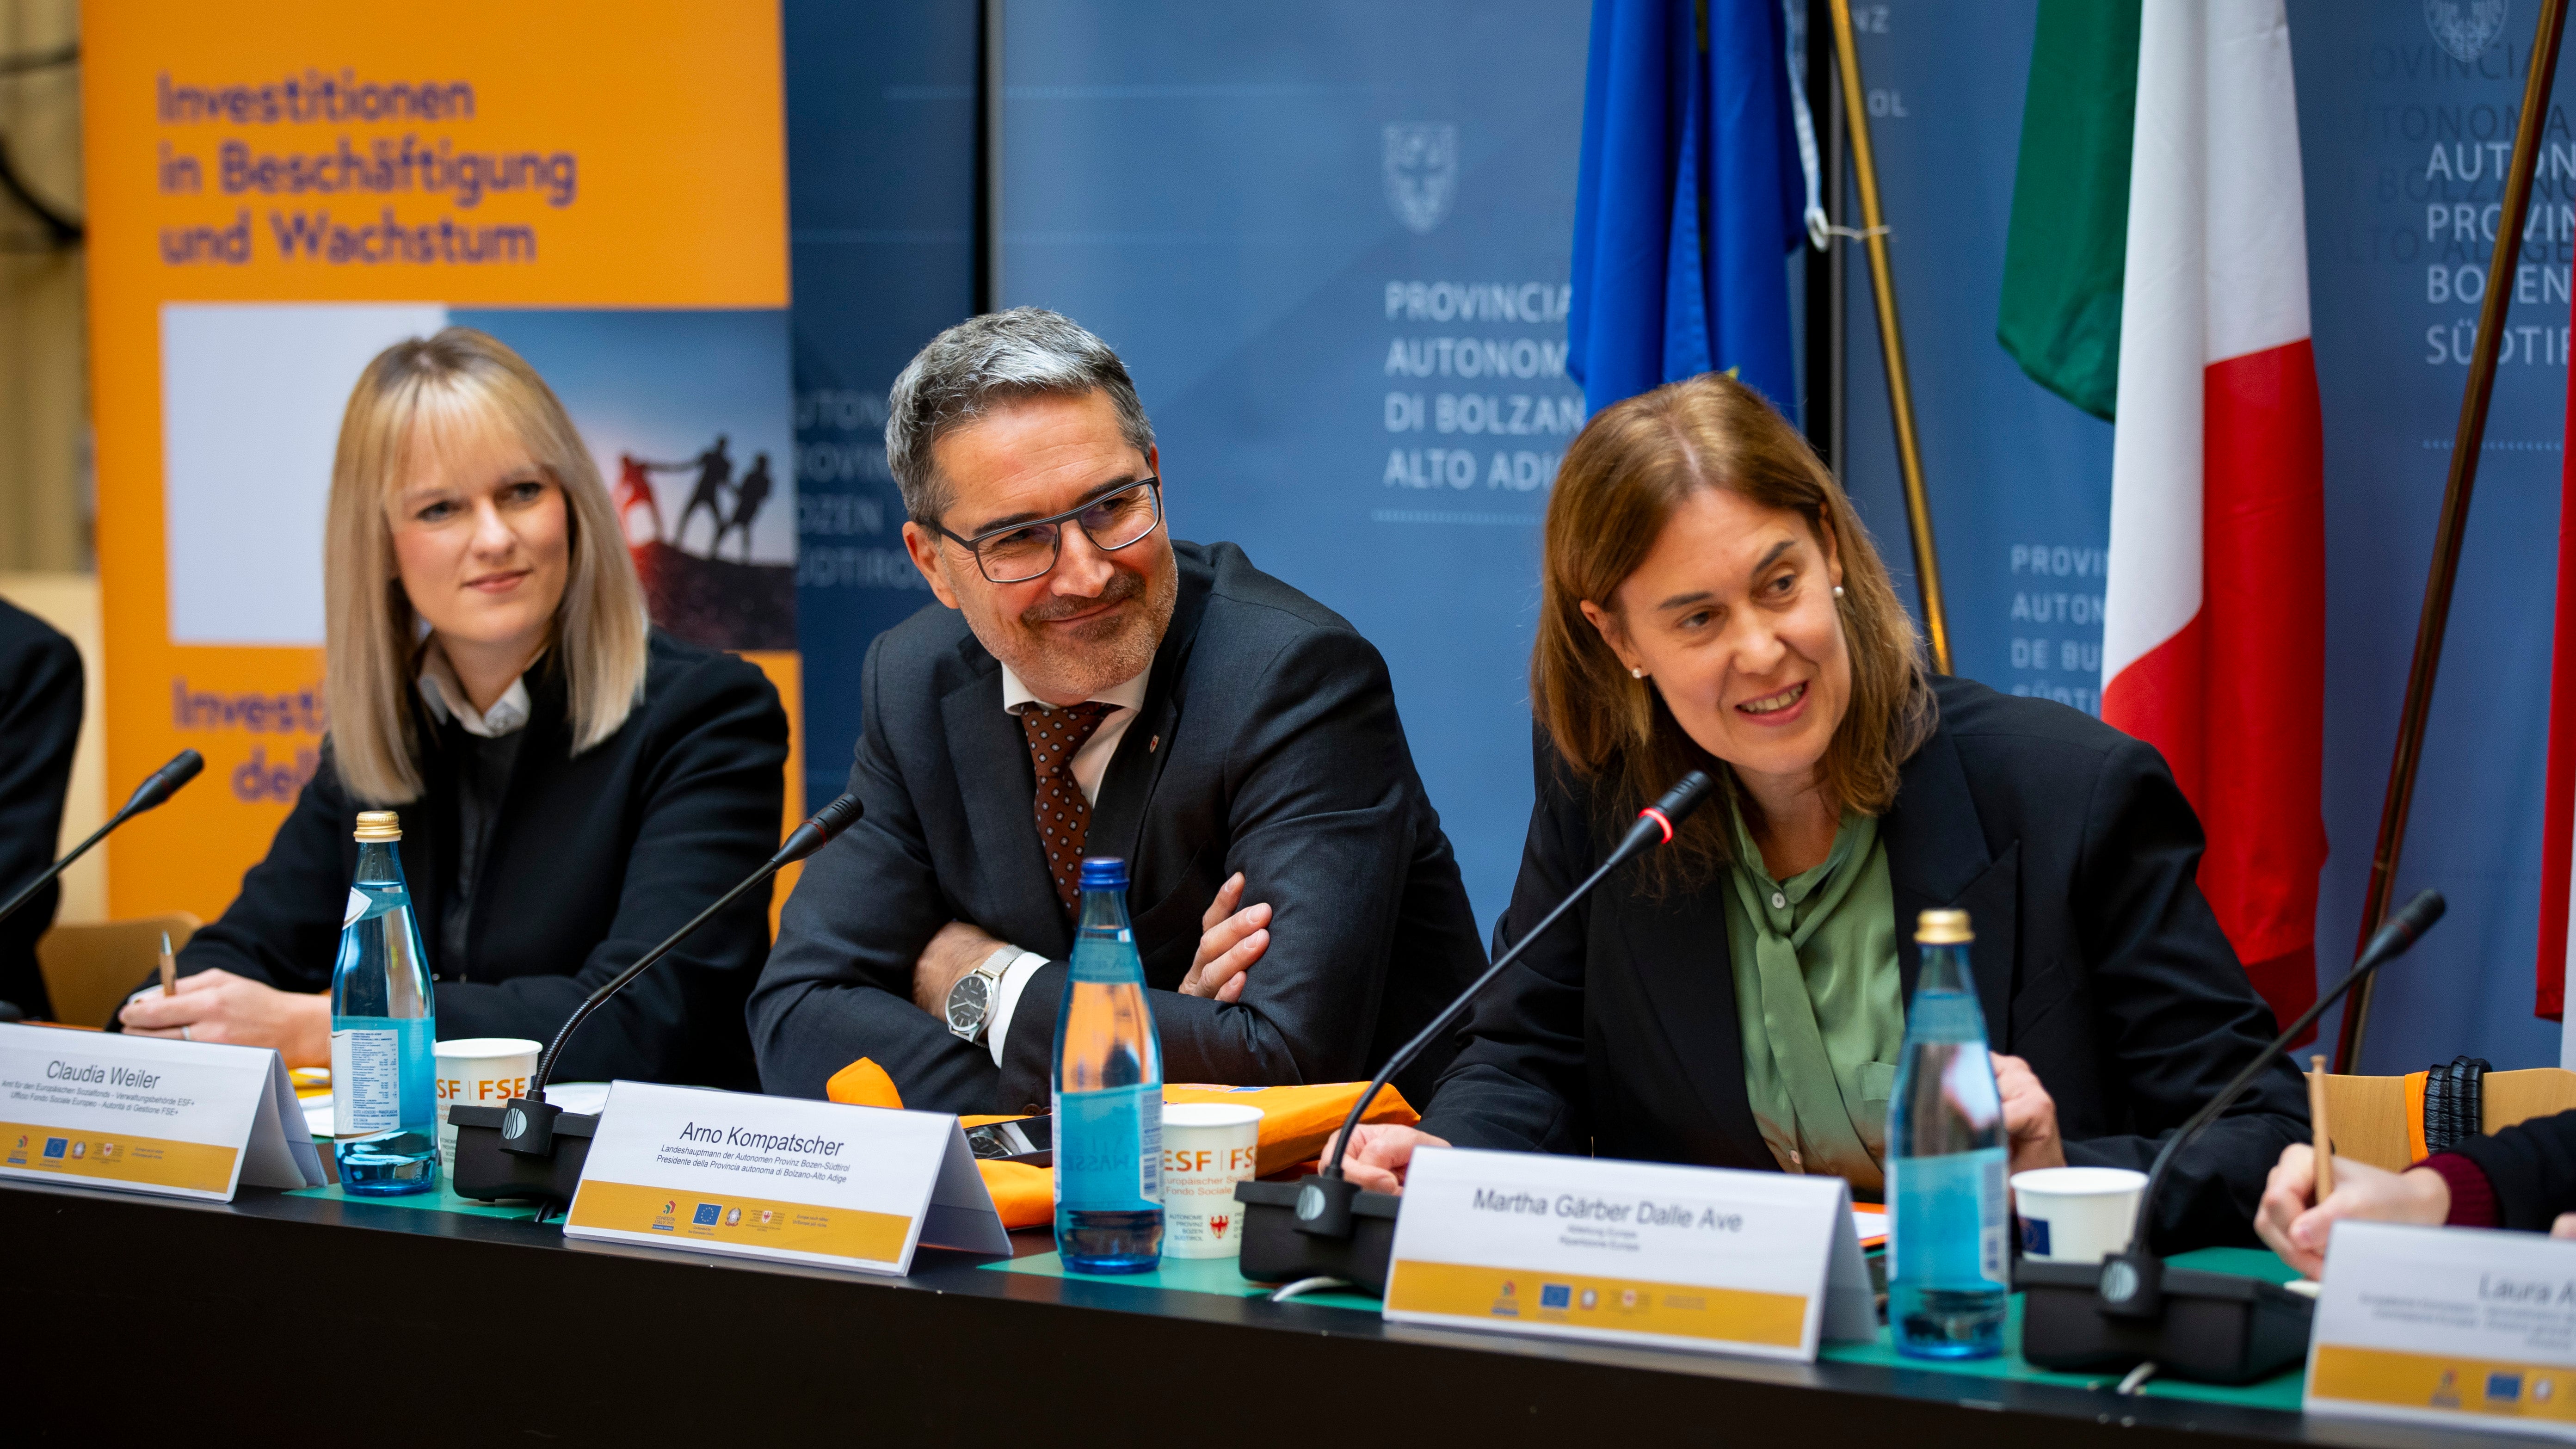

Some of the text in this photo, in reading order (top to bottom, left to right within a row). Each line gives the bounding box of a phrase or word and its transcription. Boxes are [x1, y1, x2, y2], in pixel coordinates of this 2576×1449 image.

[157, 67, 475, 124] Investitionen
[158, 133, 577, 208] in Beschäftigung
[158, 205, 538, 265] und Wachstum
[2428, 263, 2570, 304] BOEN
[1384, 447, 1478, 490] ALTO
[47, 1060, 161, 1090] Claudia Weiler
[479, 1077, 525, 1100] FSE
[160, 1107, 179, 1116] FSE+
[177, 1098, 195, 1107] ESF+
[679, 1121, 844, 1156] Arno Kompatscher
[656, 1154, 847, 1184] Presidente della Provincia autonoma di Bolzano-Alto Adige
[661, 1144, 851, 1172] Landeshauptmann der Autonomen Provinz Bozen-Südtirol
[1197, 1187, 1232, 1196] Sociale
[1473, 1188, 1743, 1233] Martha Gärber Dalle Ave
[2478, 1272, 2552, 1303] Laura
